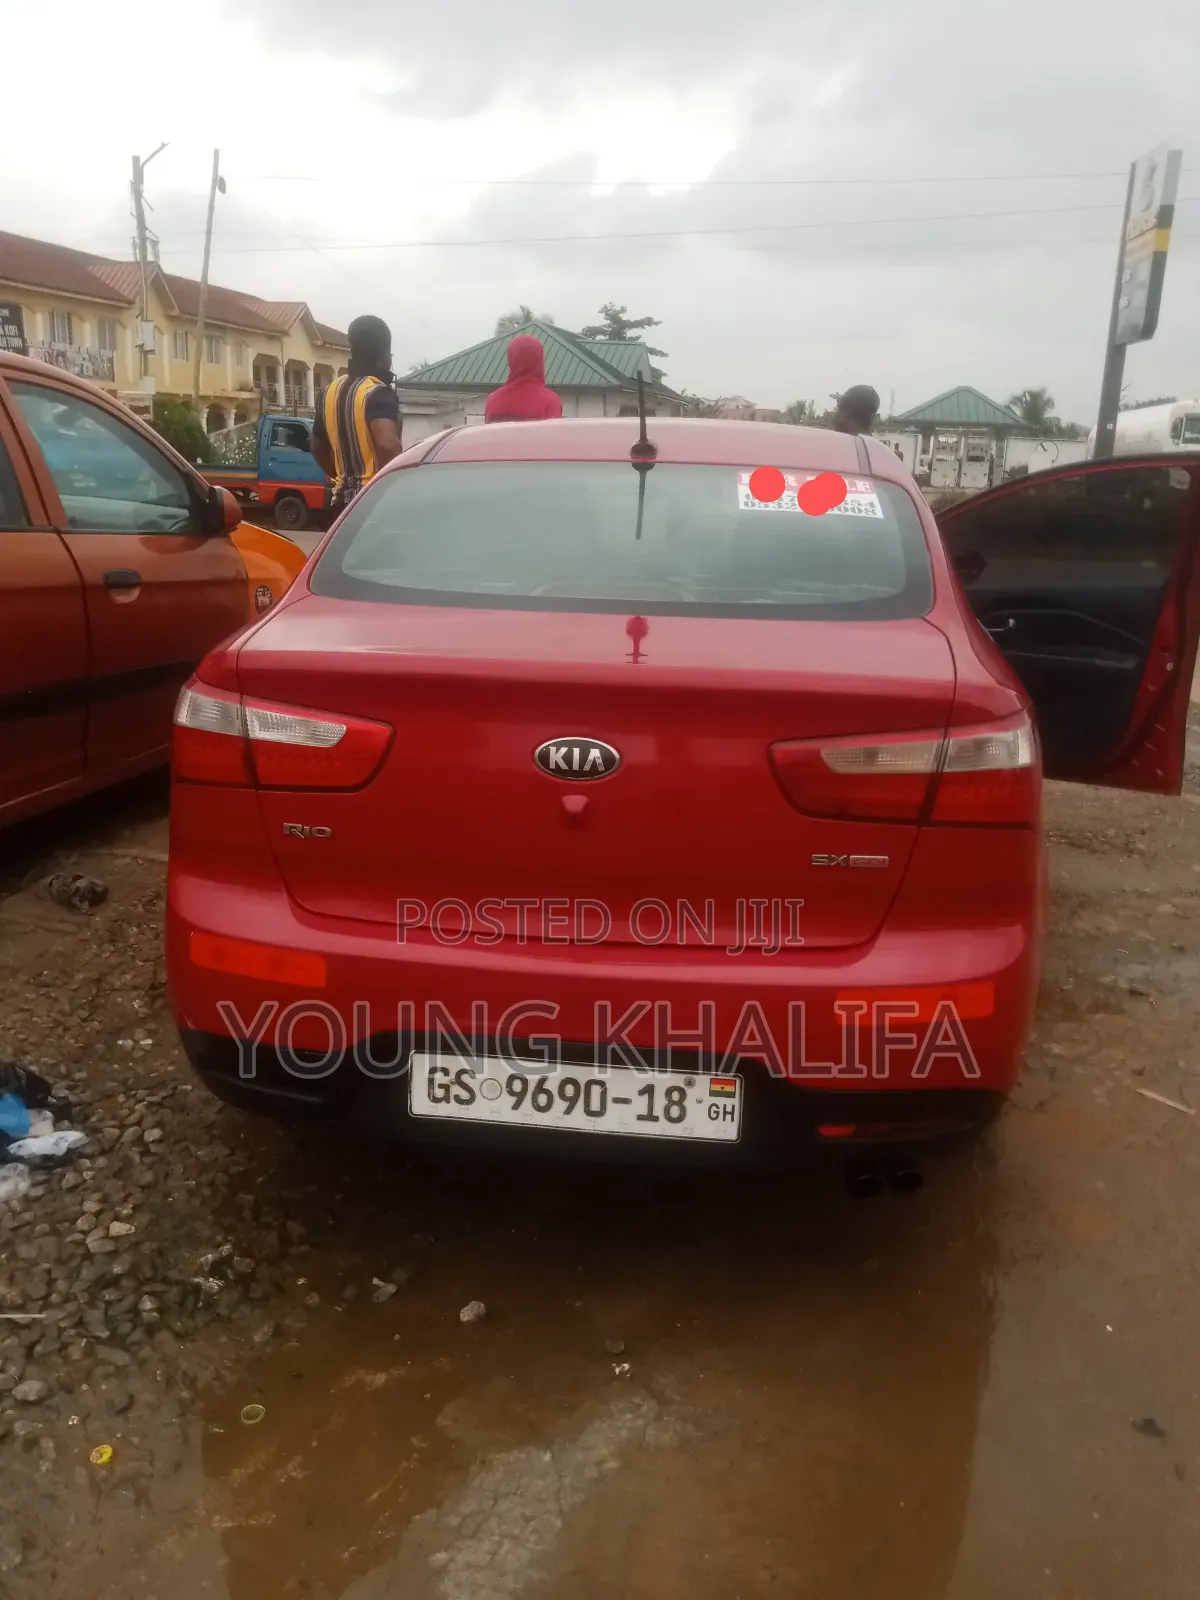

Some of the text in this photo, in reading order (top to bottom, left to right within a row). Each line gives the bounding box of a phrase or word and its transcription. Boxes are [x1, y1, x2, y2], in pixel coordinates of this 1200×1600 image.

[548, 746, 605, 771] KIA
[283, 822, 331, 838] RIO
[811, 854, 847, 866] SX
[427, 1066, 688, 1124] GS 9690-18
[707, 1103, 736, 1122] GH
